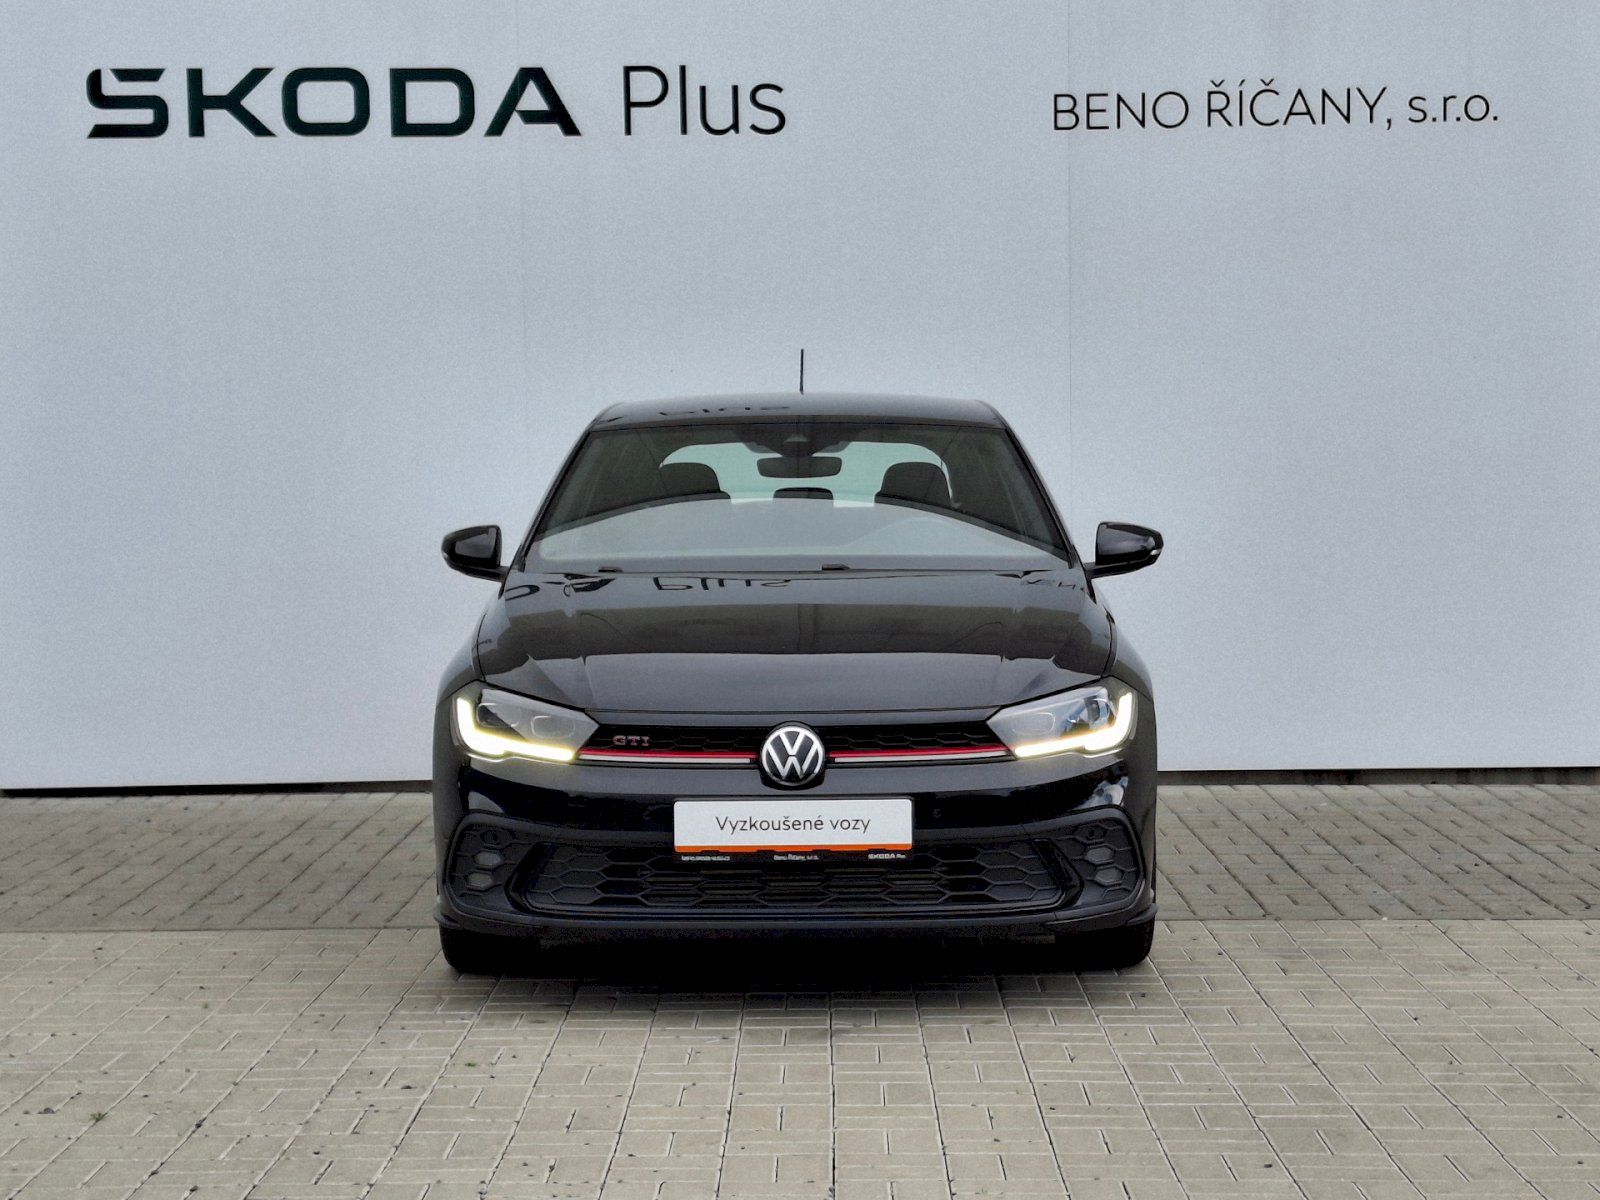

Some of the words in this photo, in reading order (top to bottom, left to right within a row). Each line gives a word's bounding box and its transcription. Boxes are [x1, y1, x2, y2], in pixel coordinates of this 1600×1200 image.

[622, 64, 787, 137] Plus
[1053, 90, 1190, 131] BENO
[1206, 78, 1393, 131] ŘÍČANY,
[1407, 94, 1499, 123] s.r.o.
[613, 735, 650, 747] GTI
[715, 815, 824, 835] Vyzkoušené
[829, 819, 871, 833] vozy
